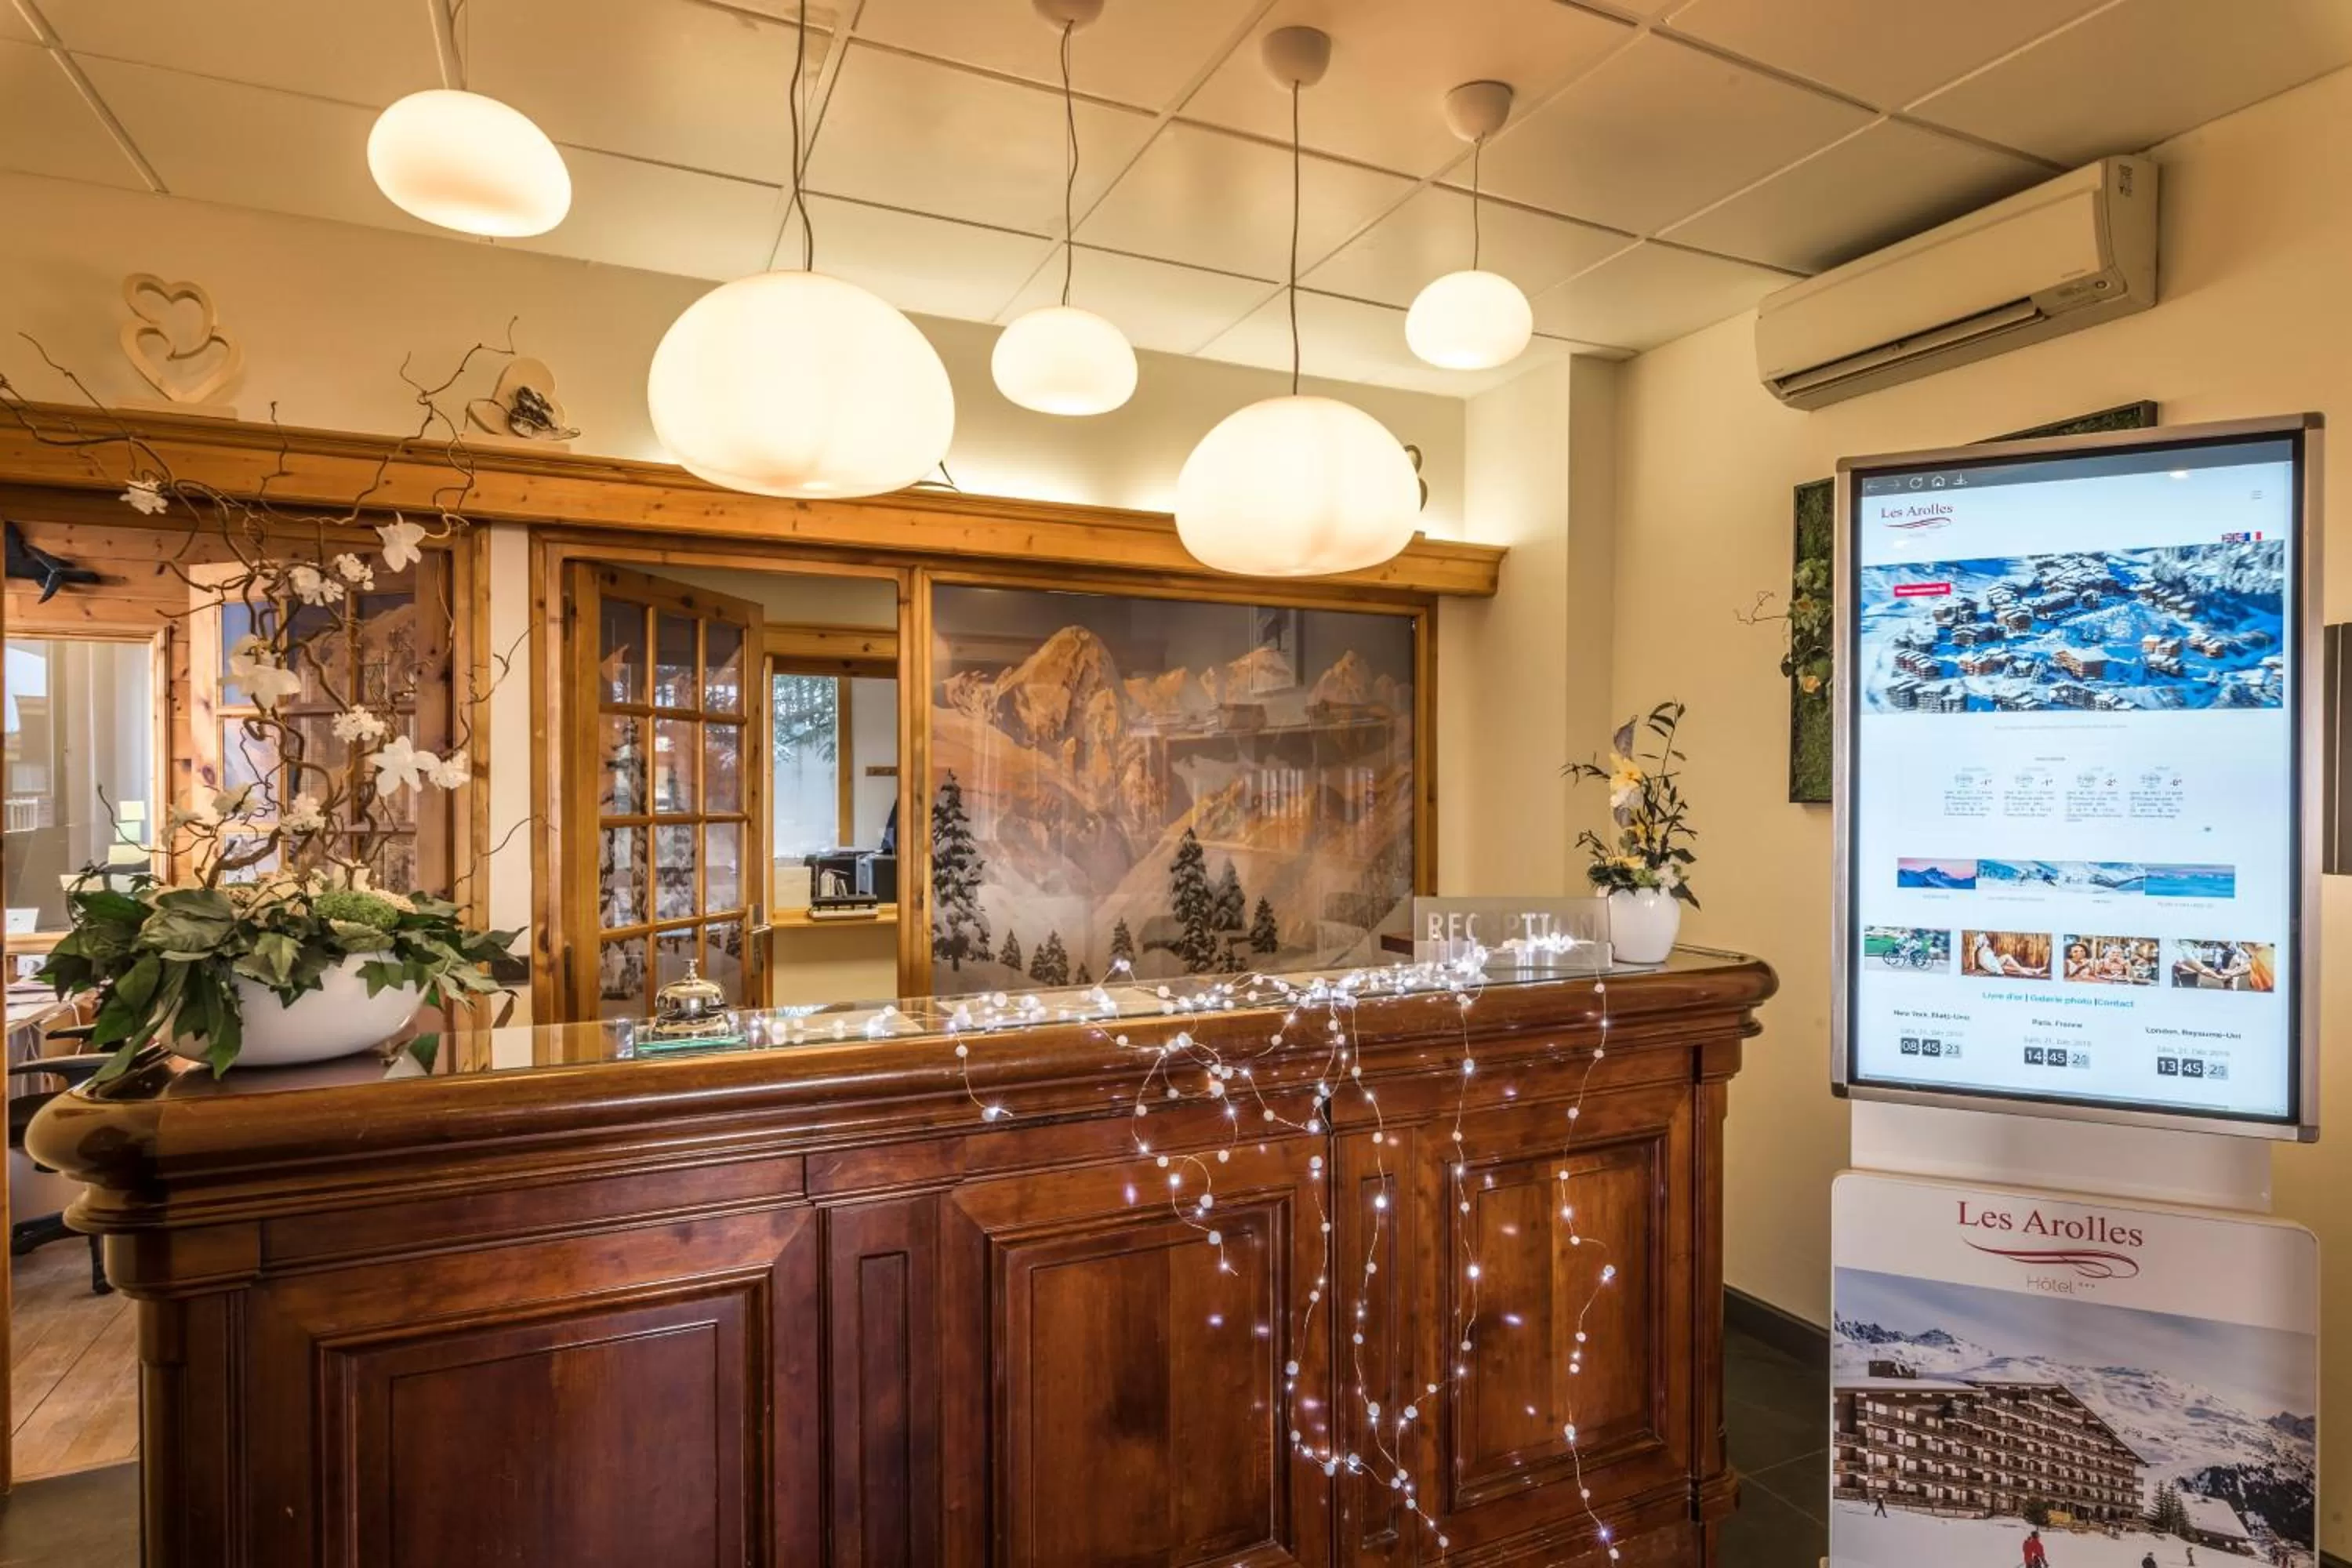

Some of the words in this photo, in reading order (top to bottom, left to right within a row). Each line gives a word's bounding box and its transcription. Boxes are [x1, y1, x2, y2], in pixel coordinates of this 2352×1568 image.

[1882, 507, 1903, 518] Les
[1907, 503, 1954, 517] Arolles
[2031, 994, 2062, 1004] Galerie
[2063, 996, 2092, 1007] photo
[1957, 1201, 2013, 1230] Les
[2023, 1210, 2143, 1247] Arolles
[2027, 1276, 2074, 1294] Hôtel
